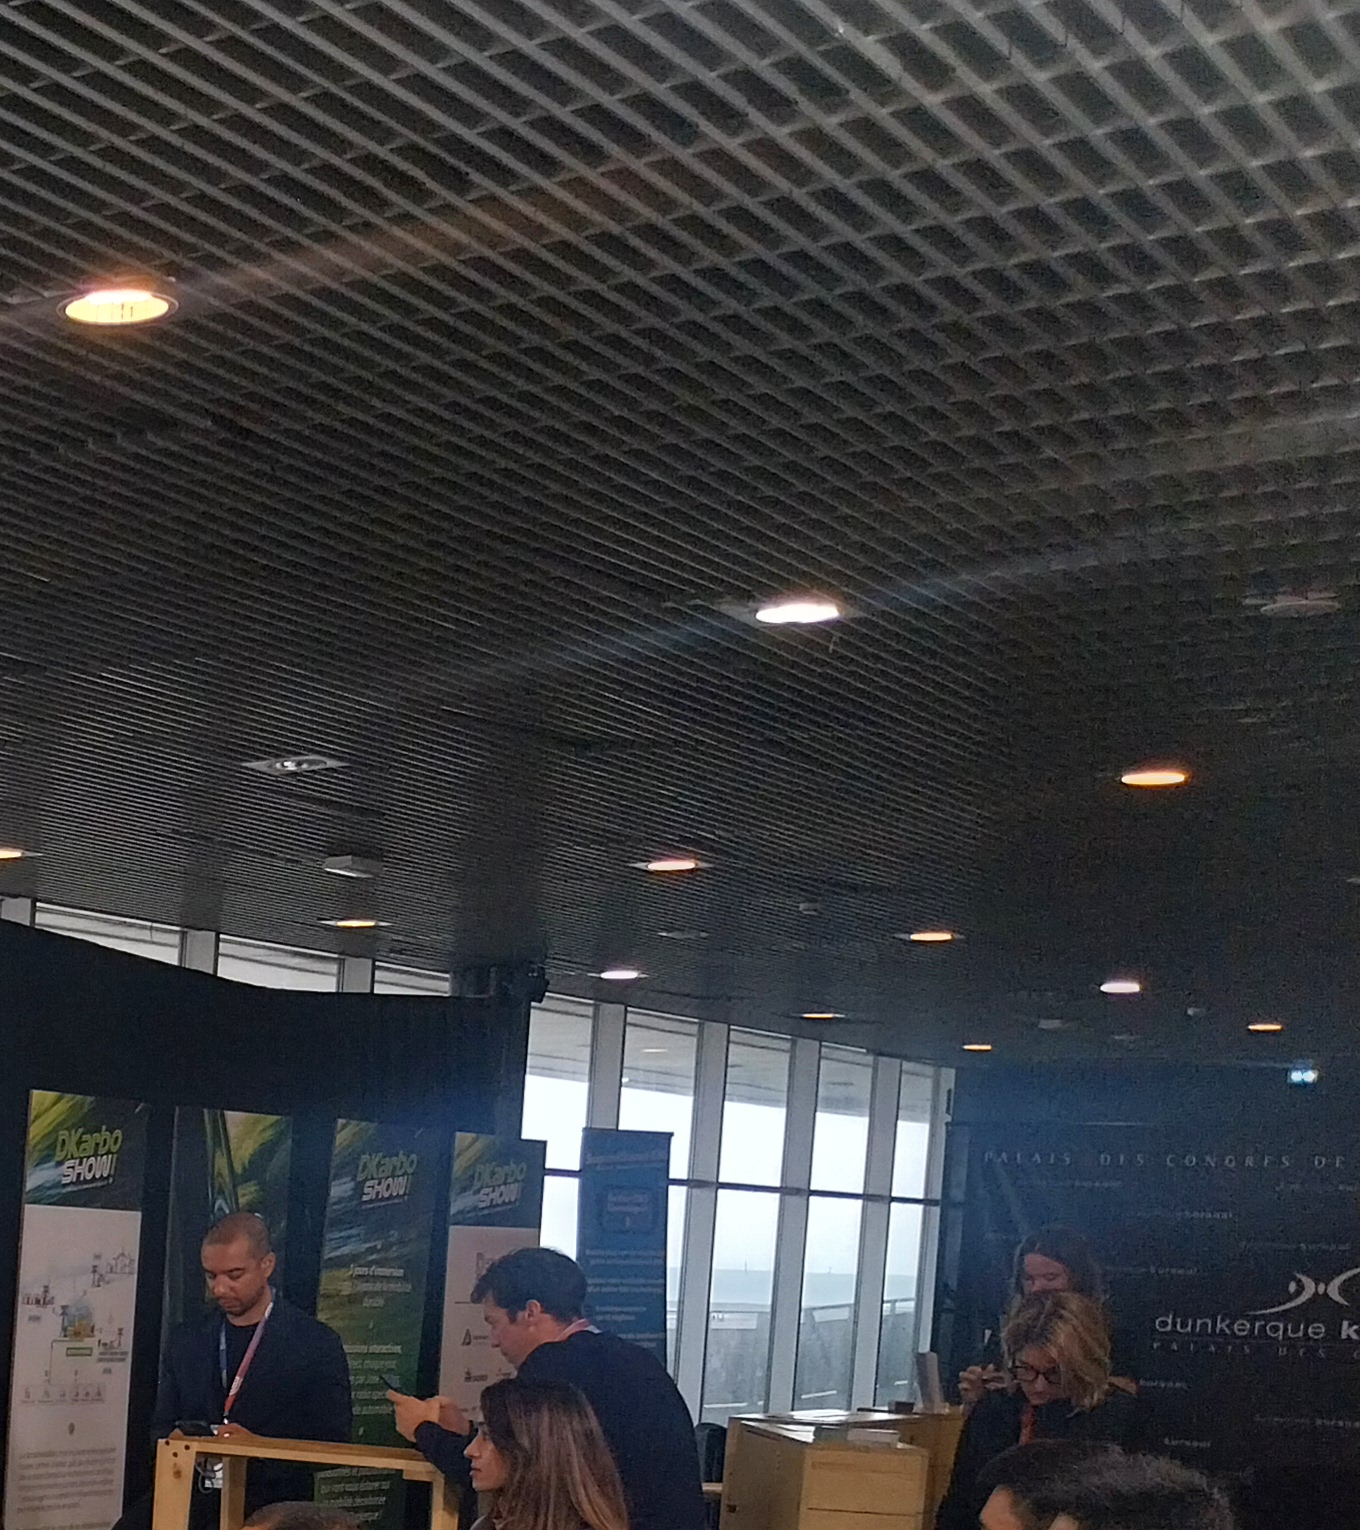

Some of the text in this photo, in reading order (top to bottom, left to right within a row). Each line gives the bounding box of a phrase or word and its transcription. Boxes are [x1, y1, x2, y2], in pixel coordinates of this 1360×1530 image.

[55, 1125, 123, 1161] DKarbo
[61, 1154, 118, 1184] SHOW!
[356, 1150, 417, 1181] DKarbo
[1155, 1312, 1326, 1340] dunkerque
